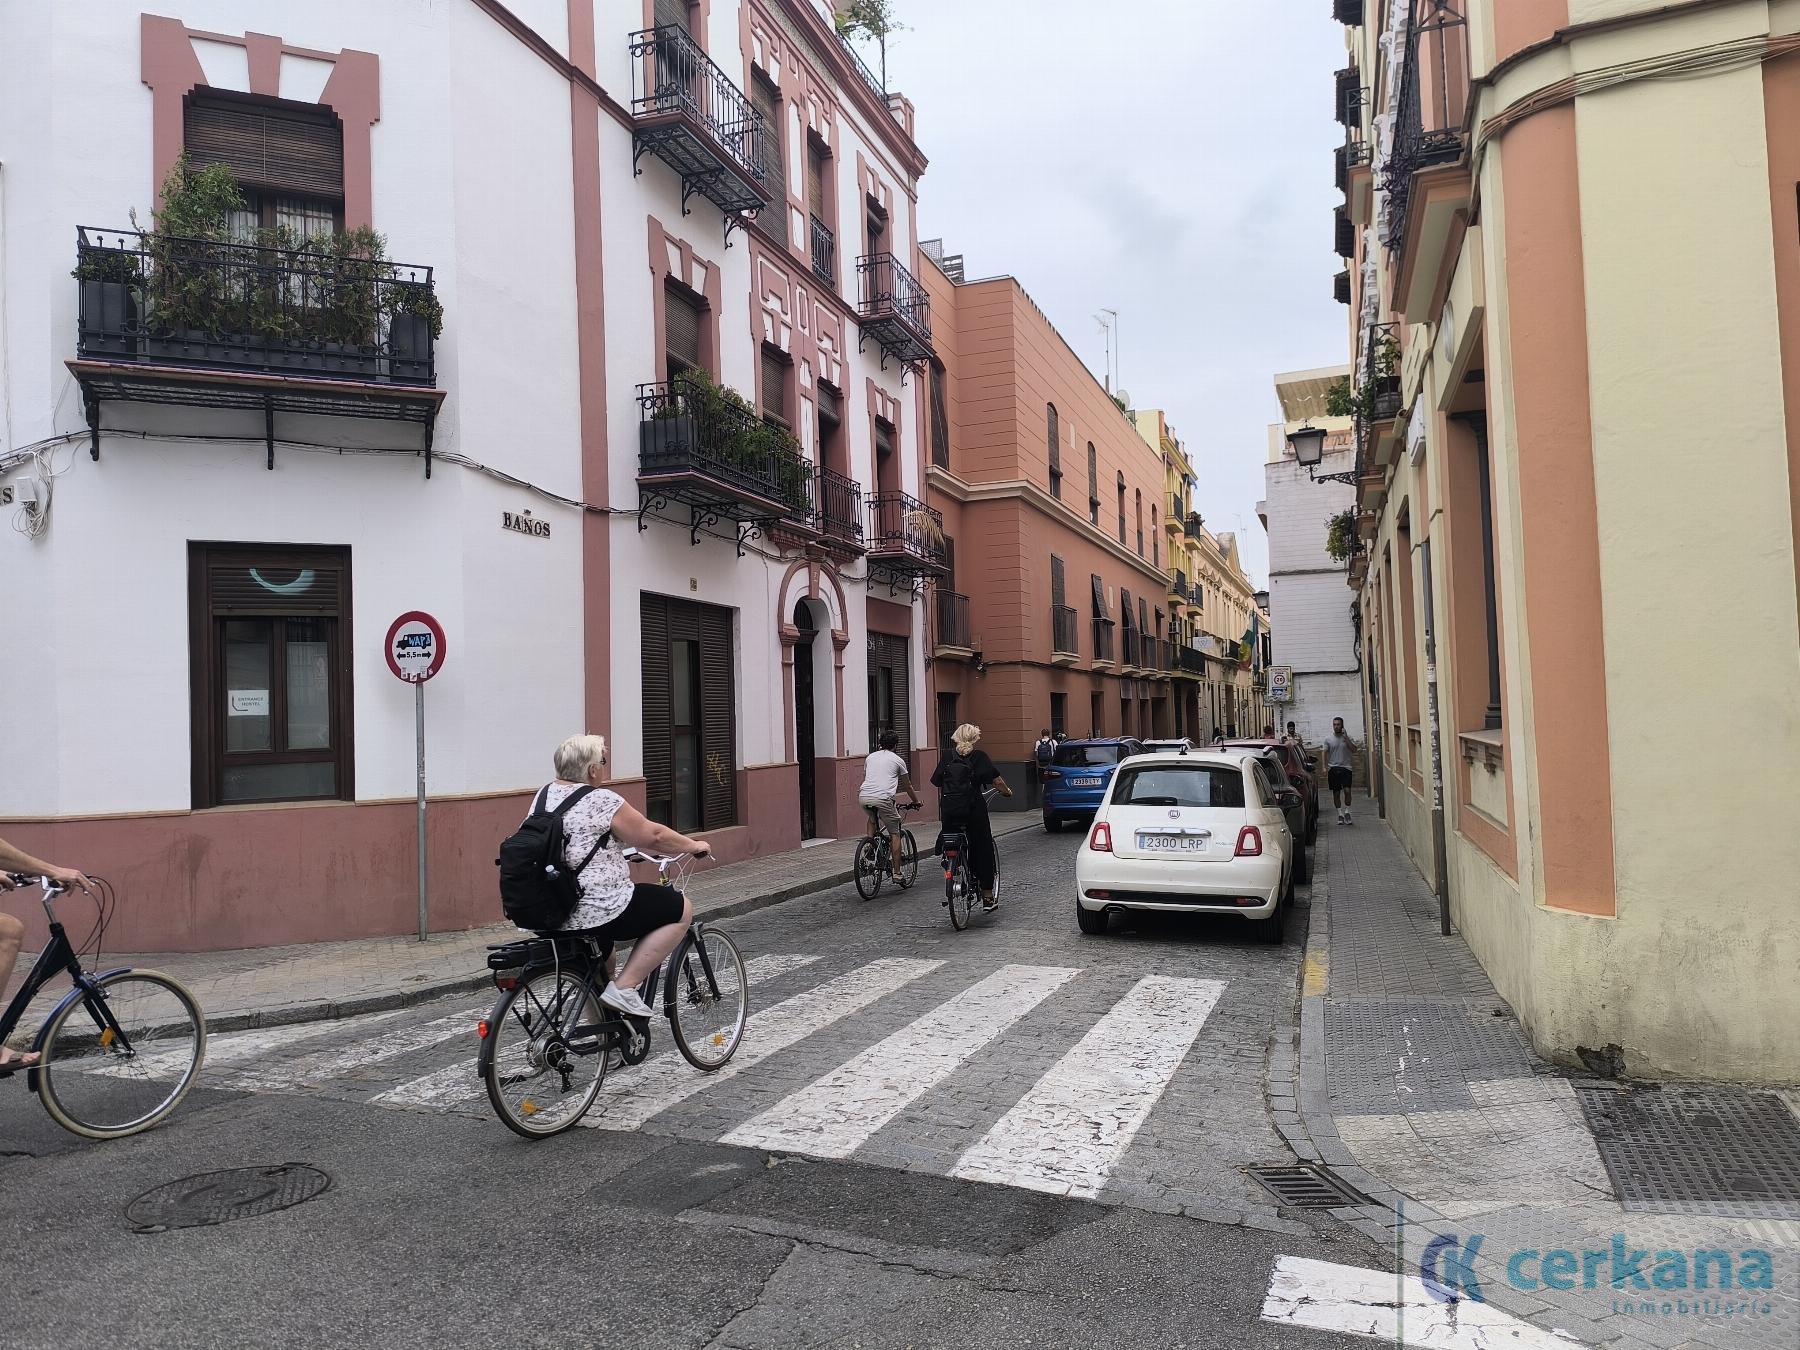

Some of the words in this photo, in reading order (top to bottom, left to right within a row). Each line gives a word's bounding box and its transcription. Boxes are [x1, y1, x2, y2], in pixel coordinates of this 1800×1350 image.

[502, 508, 551, 537] BAÑOS
[1147, 837, 1177, 849] 2300
[1180, 839, 1203, 849] LRP
